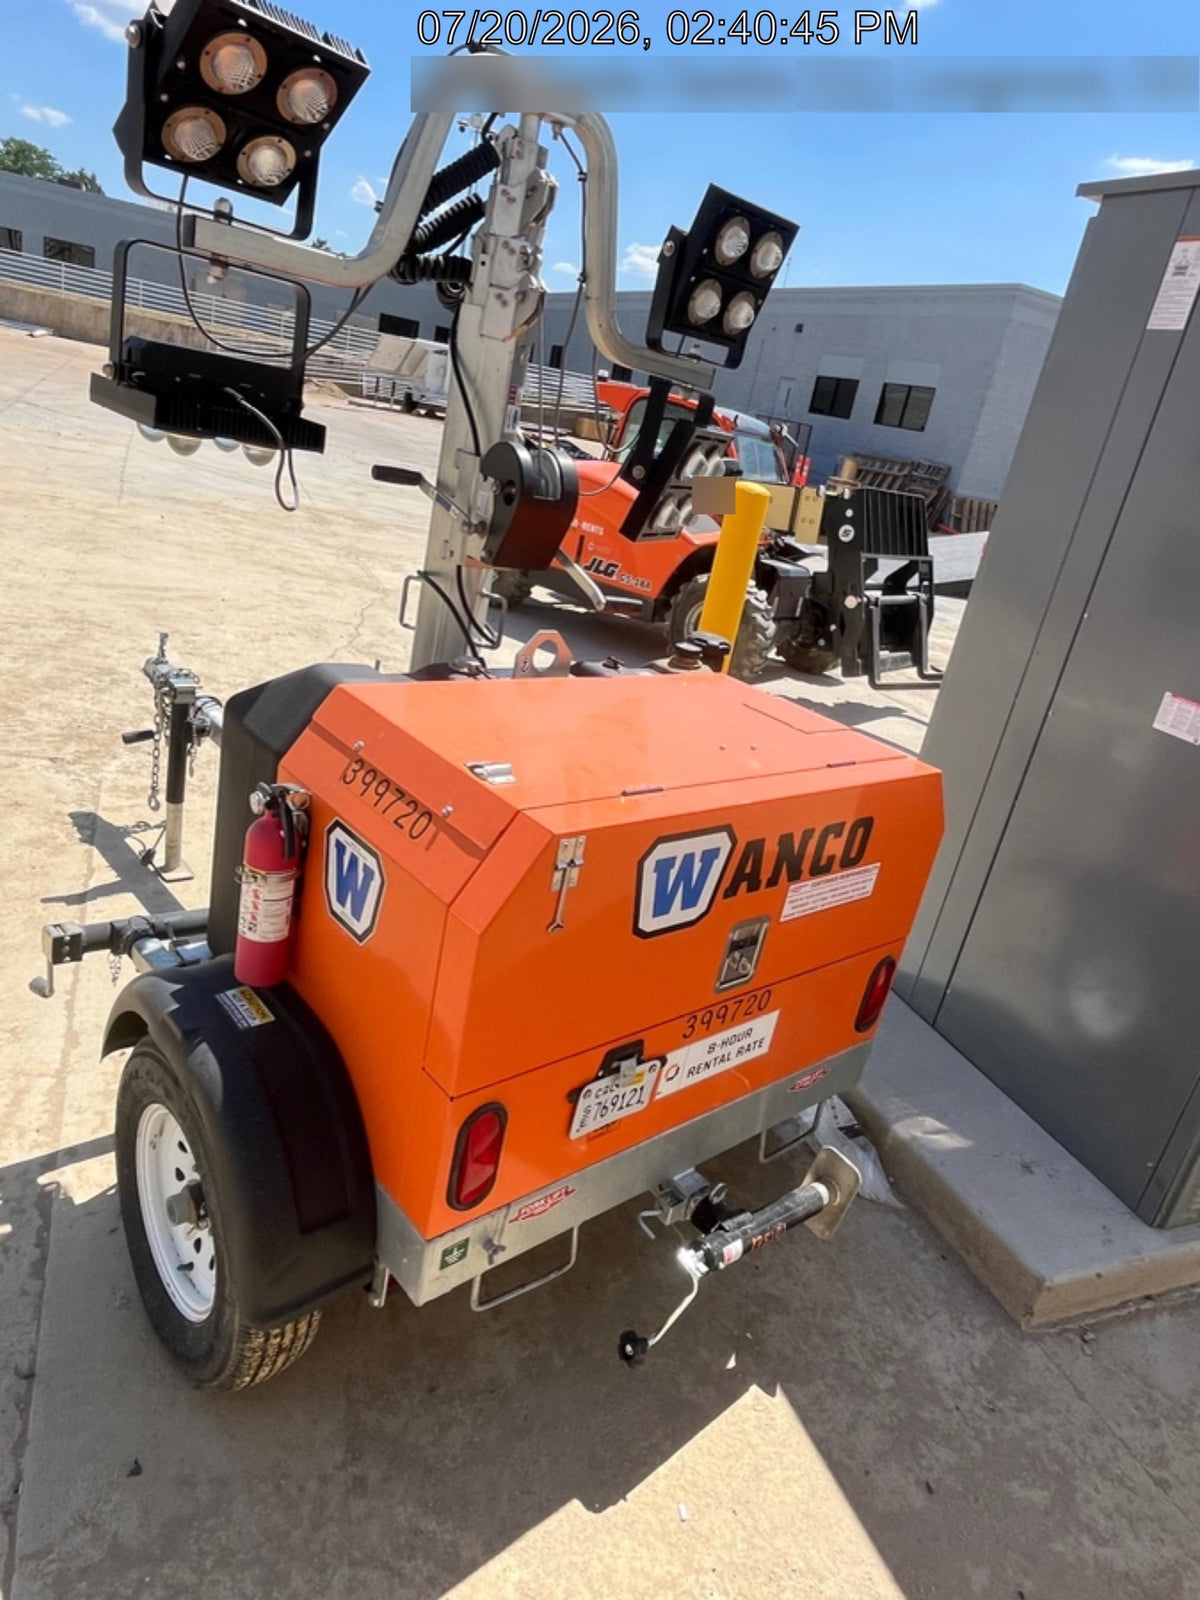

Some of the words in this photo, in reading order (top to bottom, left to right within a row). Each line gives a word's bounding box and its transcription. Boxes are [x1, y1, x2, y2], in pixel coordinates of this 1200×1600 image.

[583, 556, 620, 579] JLG
[342, 758, 433, 840] 399720
[682, 989, 772, 1039] 399720
[687, 1051, 731, 1078] RENTAL
[736, 1037, 765, 1059] RATE
[707, 1027, 754, 1055] 8-HOUR
[593, 1084, 645, 1121] 769121
